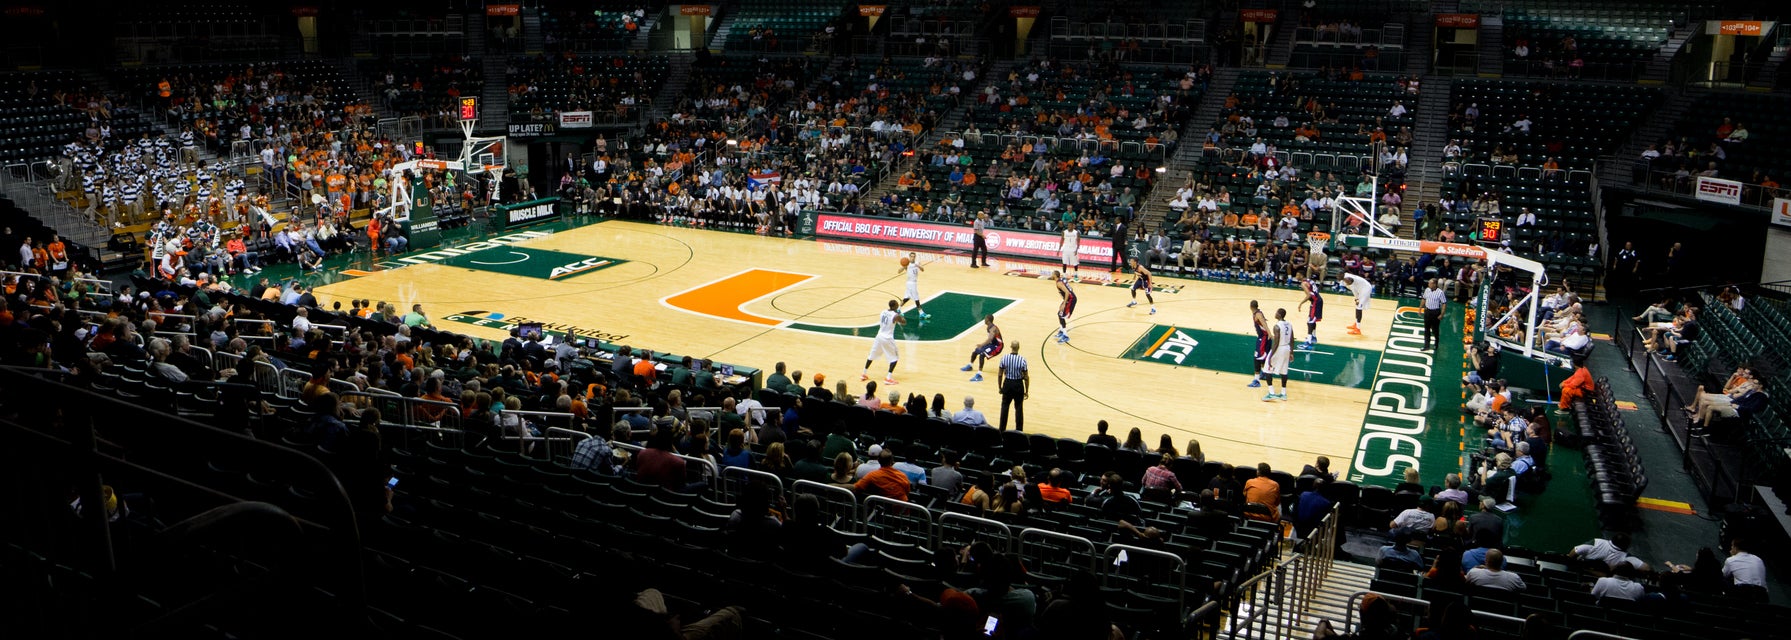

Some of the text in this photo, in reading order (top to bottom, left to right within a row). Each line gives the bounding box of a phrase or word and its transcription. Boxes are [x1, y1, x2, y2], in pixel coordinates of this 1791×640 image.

[462, 98, 474, 106] 4:23
[461, 105, 474, 119] 30
[562, 114, 590, 123] ESPN
[508, 123, 544, 133] UP LATE?
[1699, 181, 1739, 196] ESPN
[509, 203, 555, 223] MUSCLE MILK
[823, 220, 853, 232] OFFICIAL
[855, 222, 871, 233] BBQ
[871, 223, 882, 234] OF
[883, 225, 898, 236] THE
[899, 226, 943, 241] UNIVERSITY
[944, 230, 954, 242] OF
[1484, 221, 1500, 230] 4:23
[1482, 228, 1497, 239] 30
[549, 257, 609, 280] ACC
[505, 316, 630, 341] BkUnited
[1151, 329, 1199, 364] ACC
